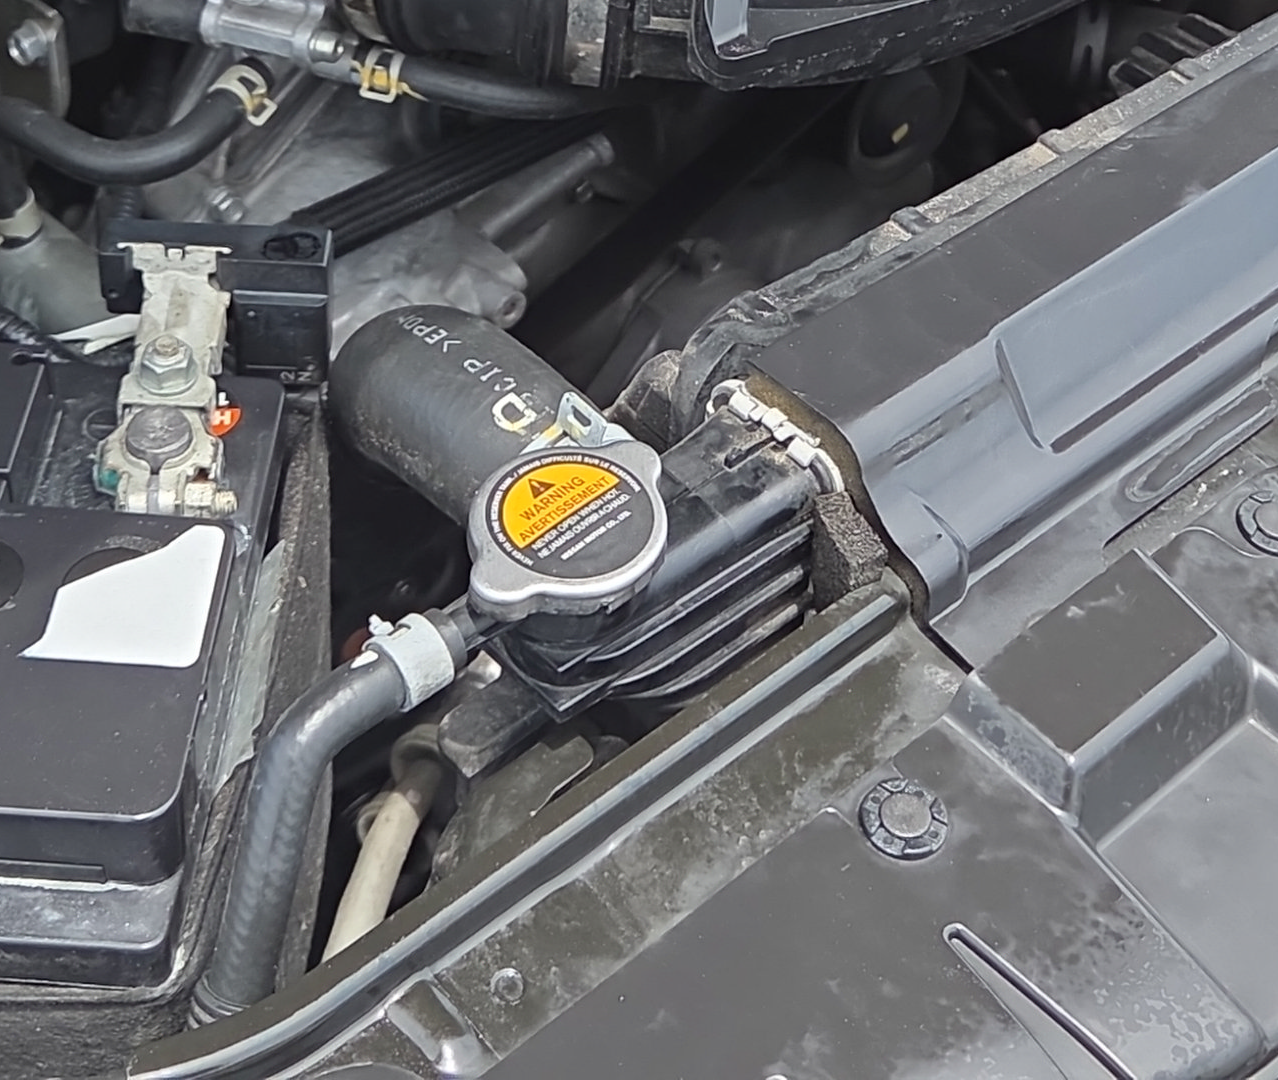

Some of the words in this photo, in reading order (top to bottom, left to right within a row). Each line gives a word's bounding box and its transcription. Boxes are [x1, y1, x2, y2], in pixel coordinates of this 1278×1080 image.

[518, 476, 610, 542] AVERTISSEMENT
[519, 476, 586, 521] WARNING
[531, 529, 559, 551] NEVER
[557, 514, 581, 533] OPEN
[579, 498, 603, 518] WHEN
[601, 487, 621, 503] HOT.
[537, 546, 551, 558] NE
[548, 530, 574, 555] JAMAIS
[602, 493, 632, 514] CHAUD.
